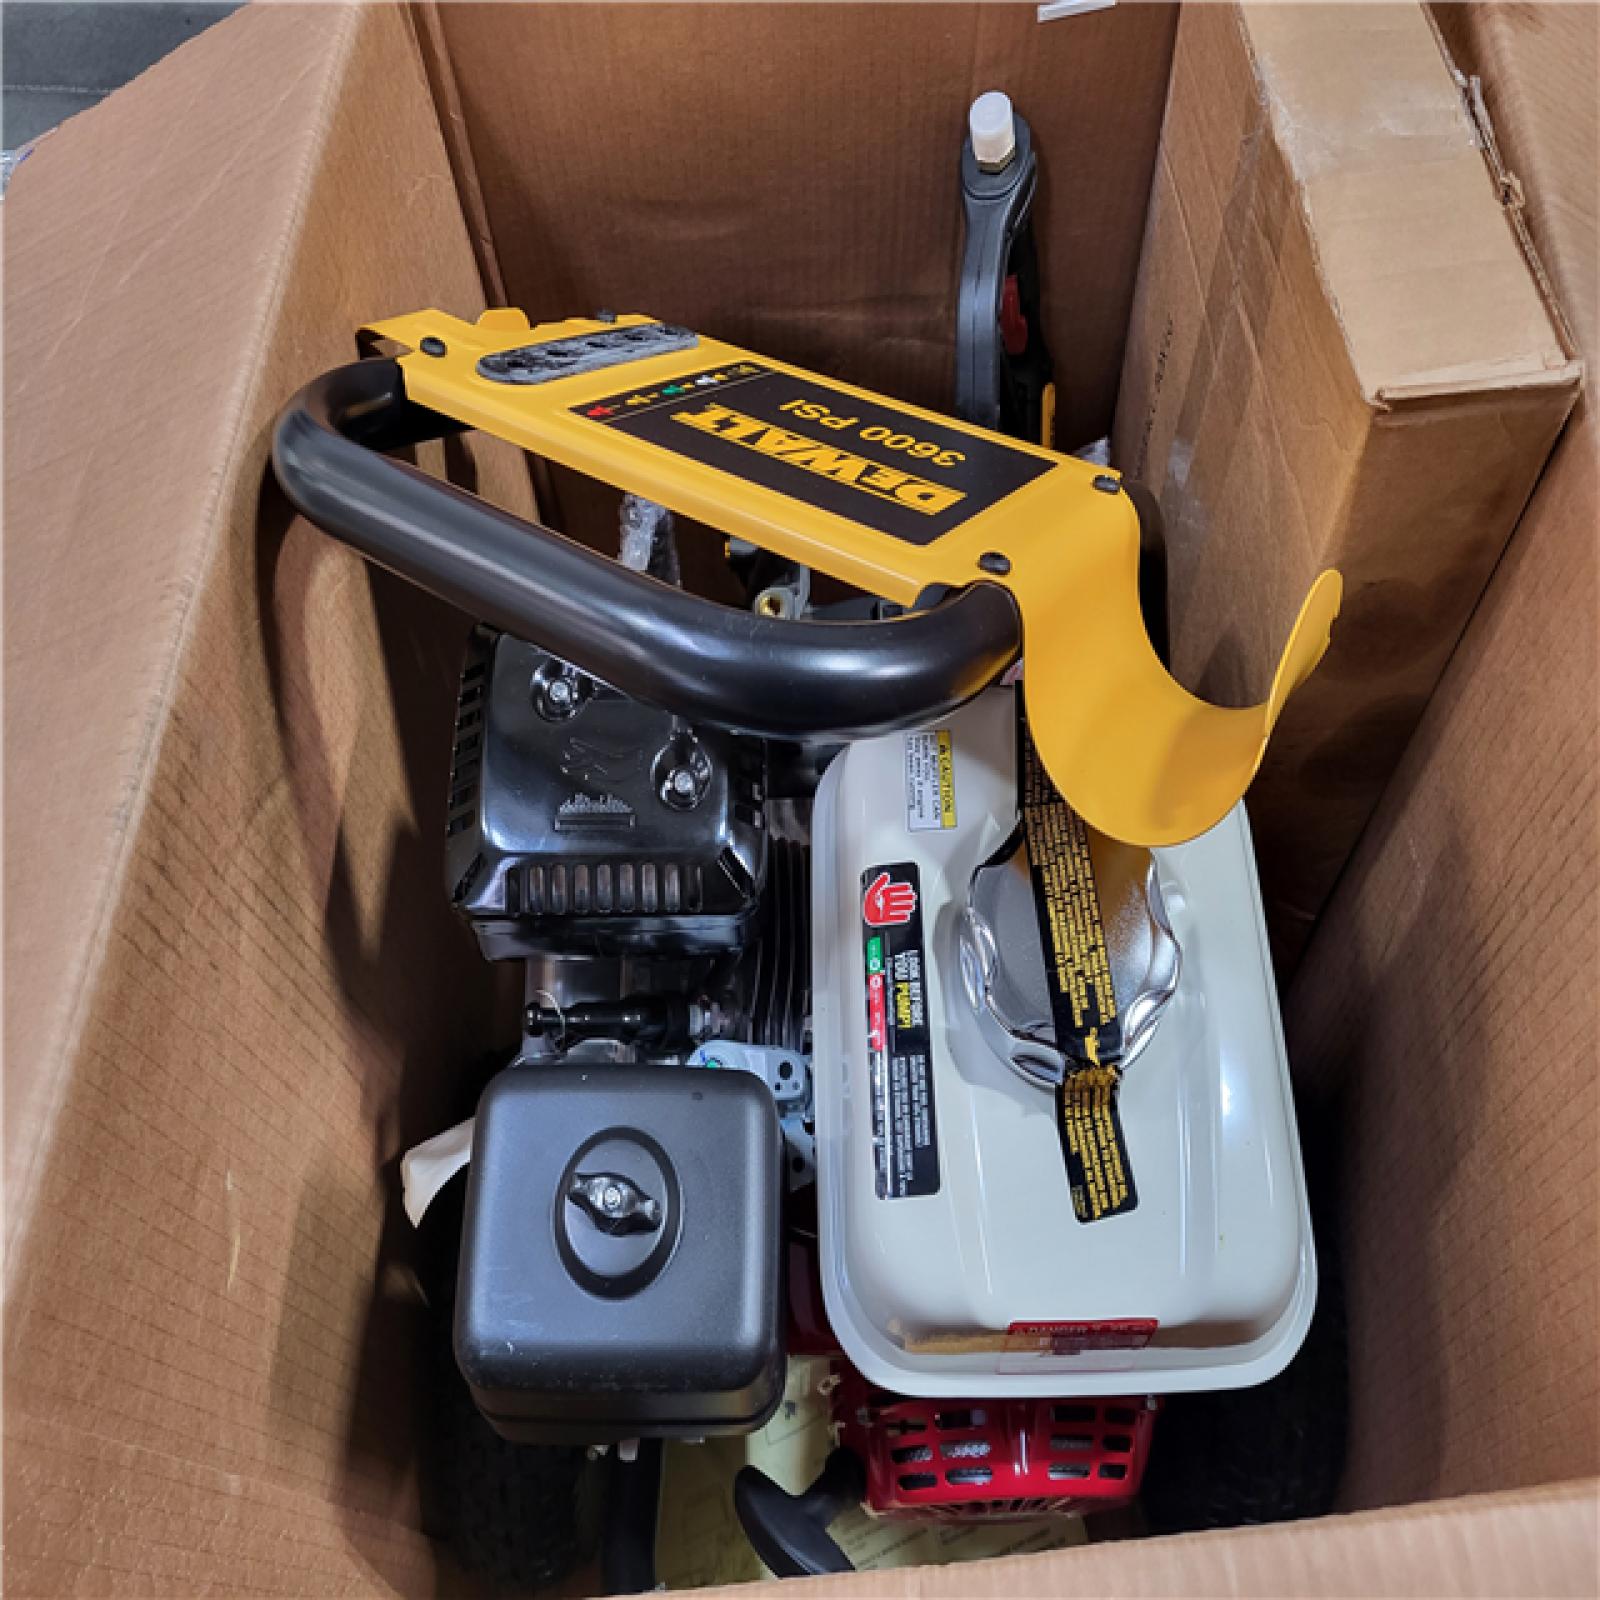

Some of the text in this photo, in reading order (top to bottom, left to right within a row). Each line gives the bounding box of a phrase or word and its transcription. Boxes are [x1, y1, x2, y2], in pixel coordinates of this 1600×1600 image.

[670, 402, 967, 515] DEWALT
[778, 398, 966, 466] 3600 PSI
